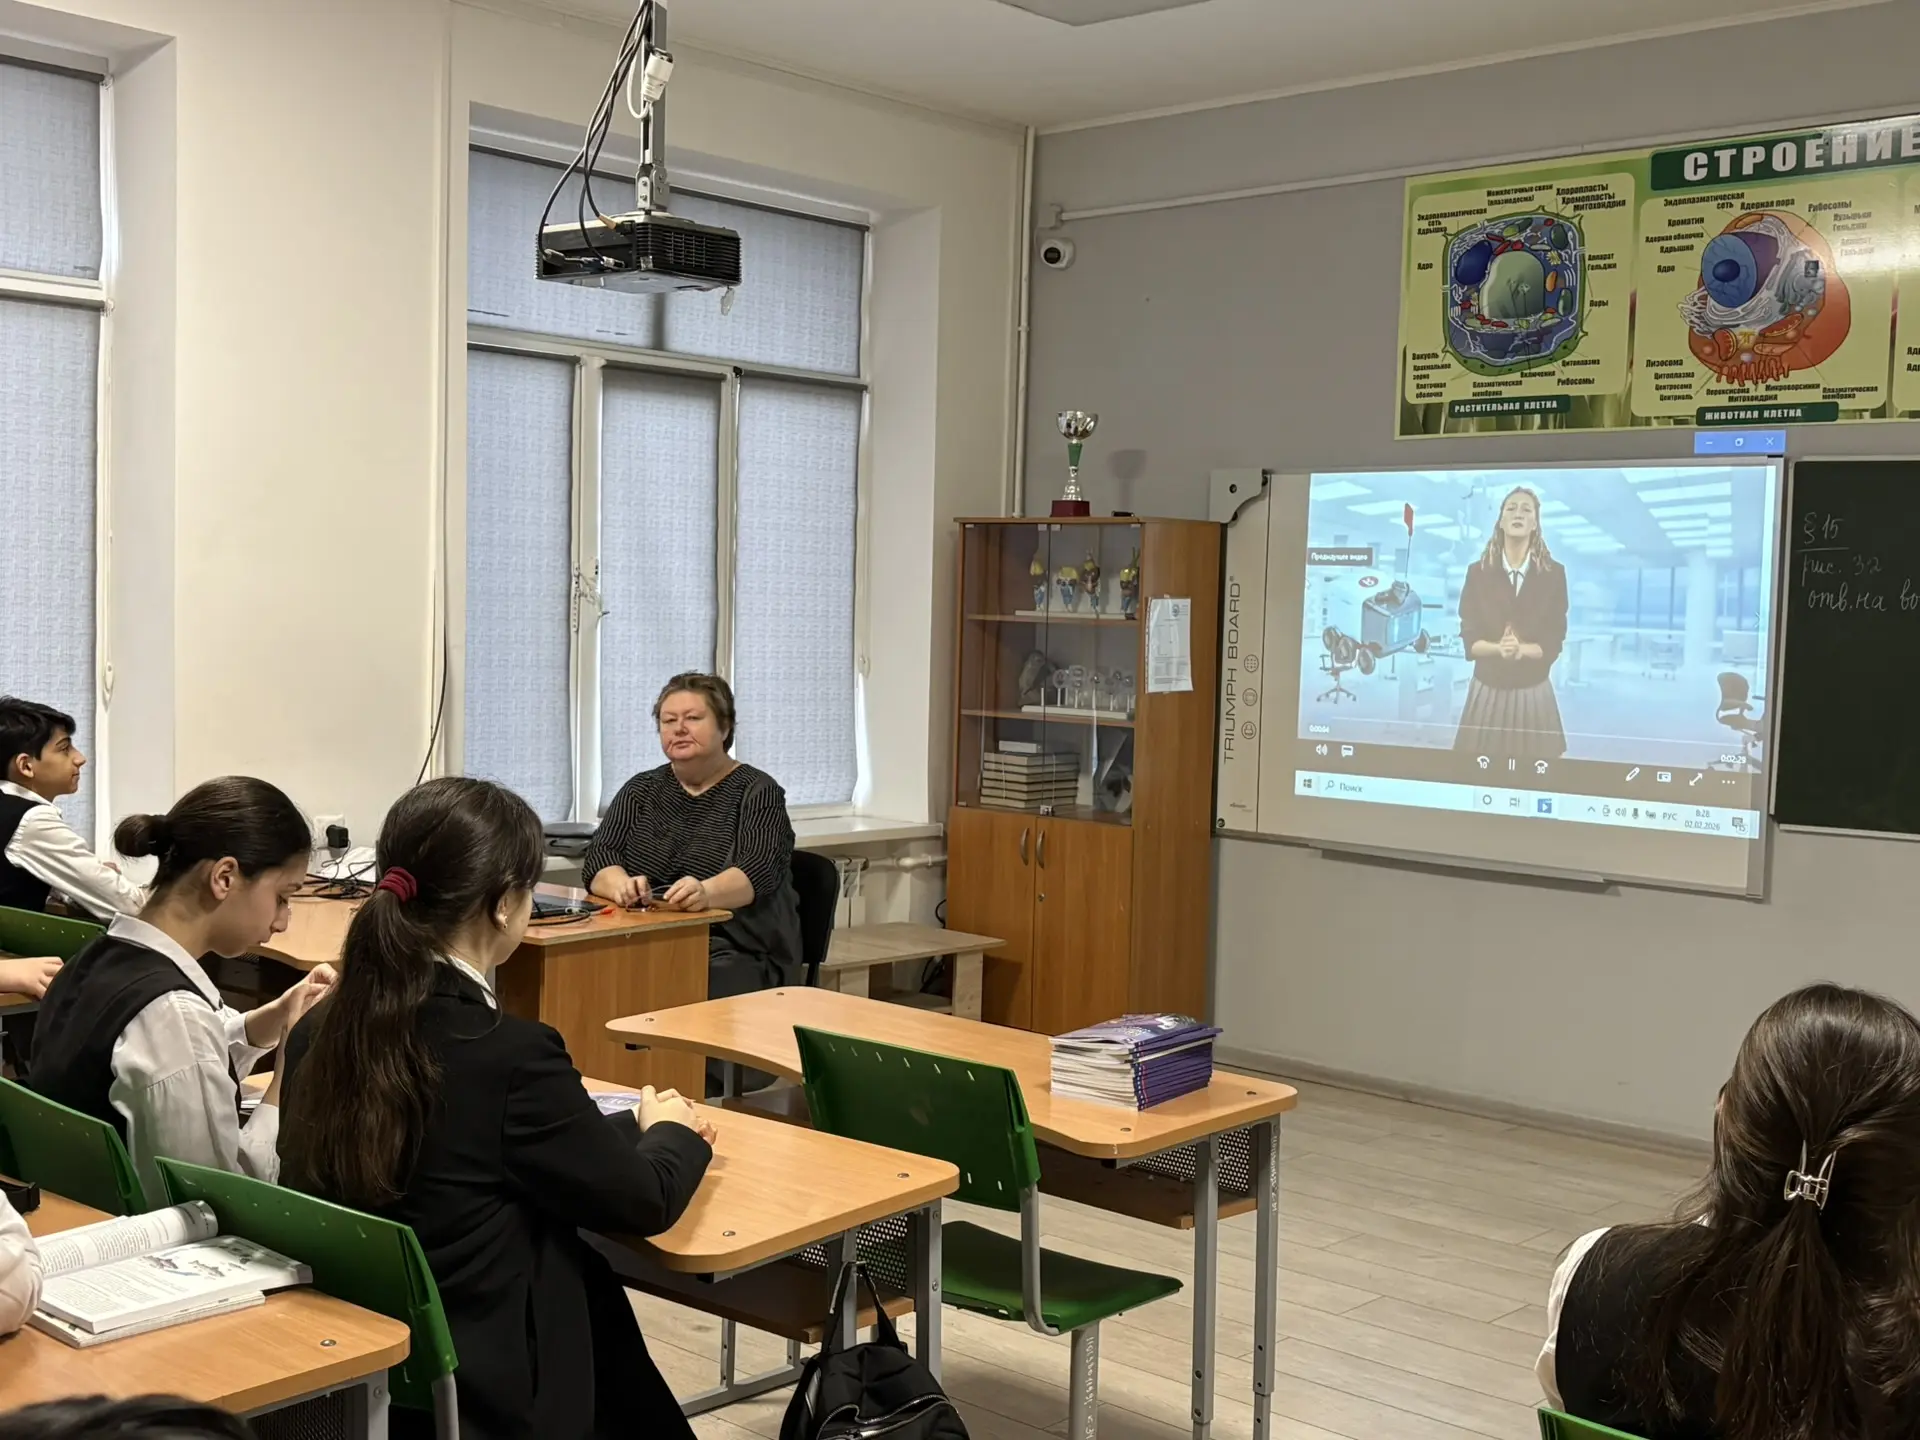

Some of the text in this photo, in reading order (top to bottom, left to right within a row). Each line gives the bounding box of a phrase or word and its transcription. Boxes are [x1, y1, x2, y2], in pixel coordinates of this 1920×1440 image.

[1684, 127, 1920, 181] СТРОЕНИЕ
[1556, 184, 1608, 196] Хлоропласты
[1562, 193, 1615, 205] Хромопласты
[1664, 192, 1744, 207] Эндоплазматическая
[1740, 198, 1795, 211] Ядерная пора
[1807, 201, 1852, 212] Рибосомы
[1668, 217, 1704, 227] Хроматин
[1645, 232, 1704, 243] Ядерная оболочка
[1660, 244, 1694, 253] Ядрышко
[1588, 253, 1614, 261] Аппарат
[1417, 262, 1433, 270] Ядро
[1588, 263, 1617, 271] Гольджи
[1657, 264, 1675, 273] Ядро
[1590, 300, 1609, 308] Поры
[1562, 359, 1600, 367] Цитоплазма
[1646, 359, 1683, 367] Лизосома
[1654, 372, 1695, 380] Цитоплазма
[1473, 380, 1523, 388] Плазматическая
[1557, 378, 1595, 386] Рибосомы
[1765, 383, 1820, 391] Микроворсинки
[1822, 386, 1878, 394] Плазматическая
[1454, 400, 1557, 412] РАСТИТЕЛЬНАЯ КЛЕТКА
[1705, 408, 1802, 420] ЖИВОТНАЯ КЛЕТКА
[1822, 513, 1845, 539] 15
[1224, 668, 1237, 765] TRIUMPH
[1340, 782, 1363, 792] Поиск
[1662, 812, 1678, 820] РУС
[1695, 809, 1710, 817] 8:28
[1684, 819, 1720, 831] 02.02.2026
